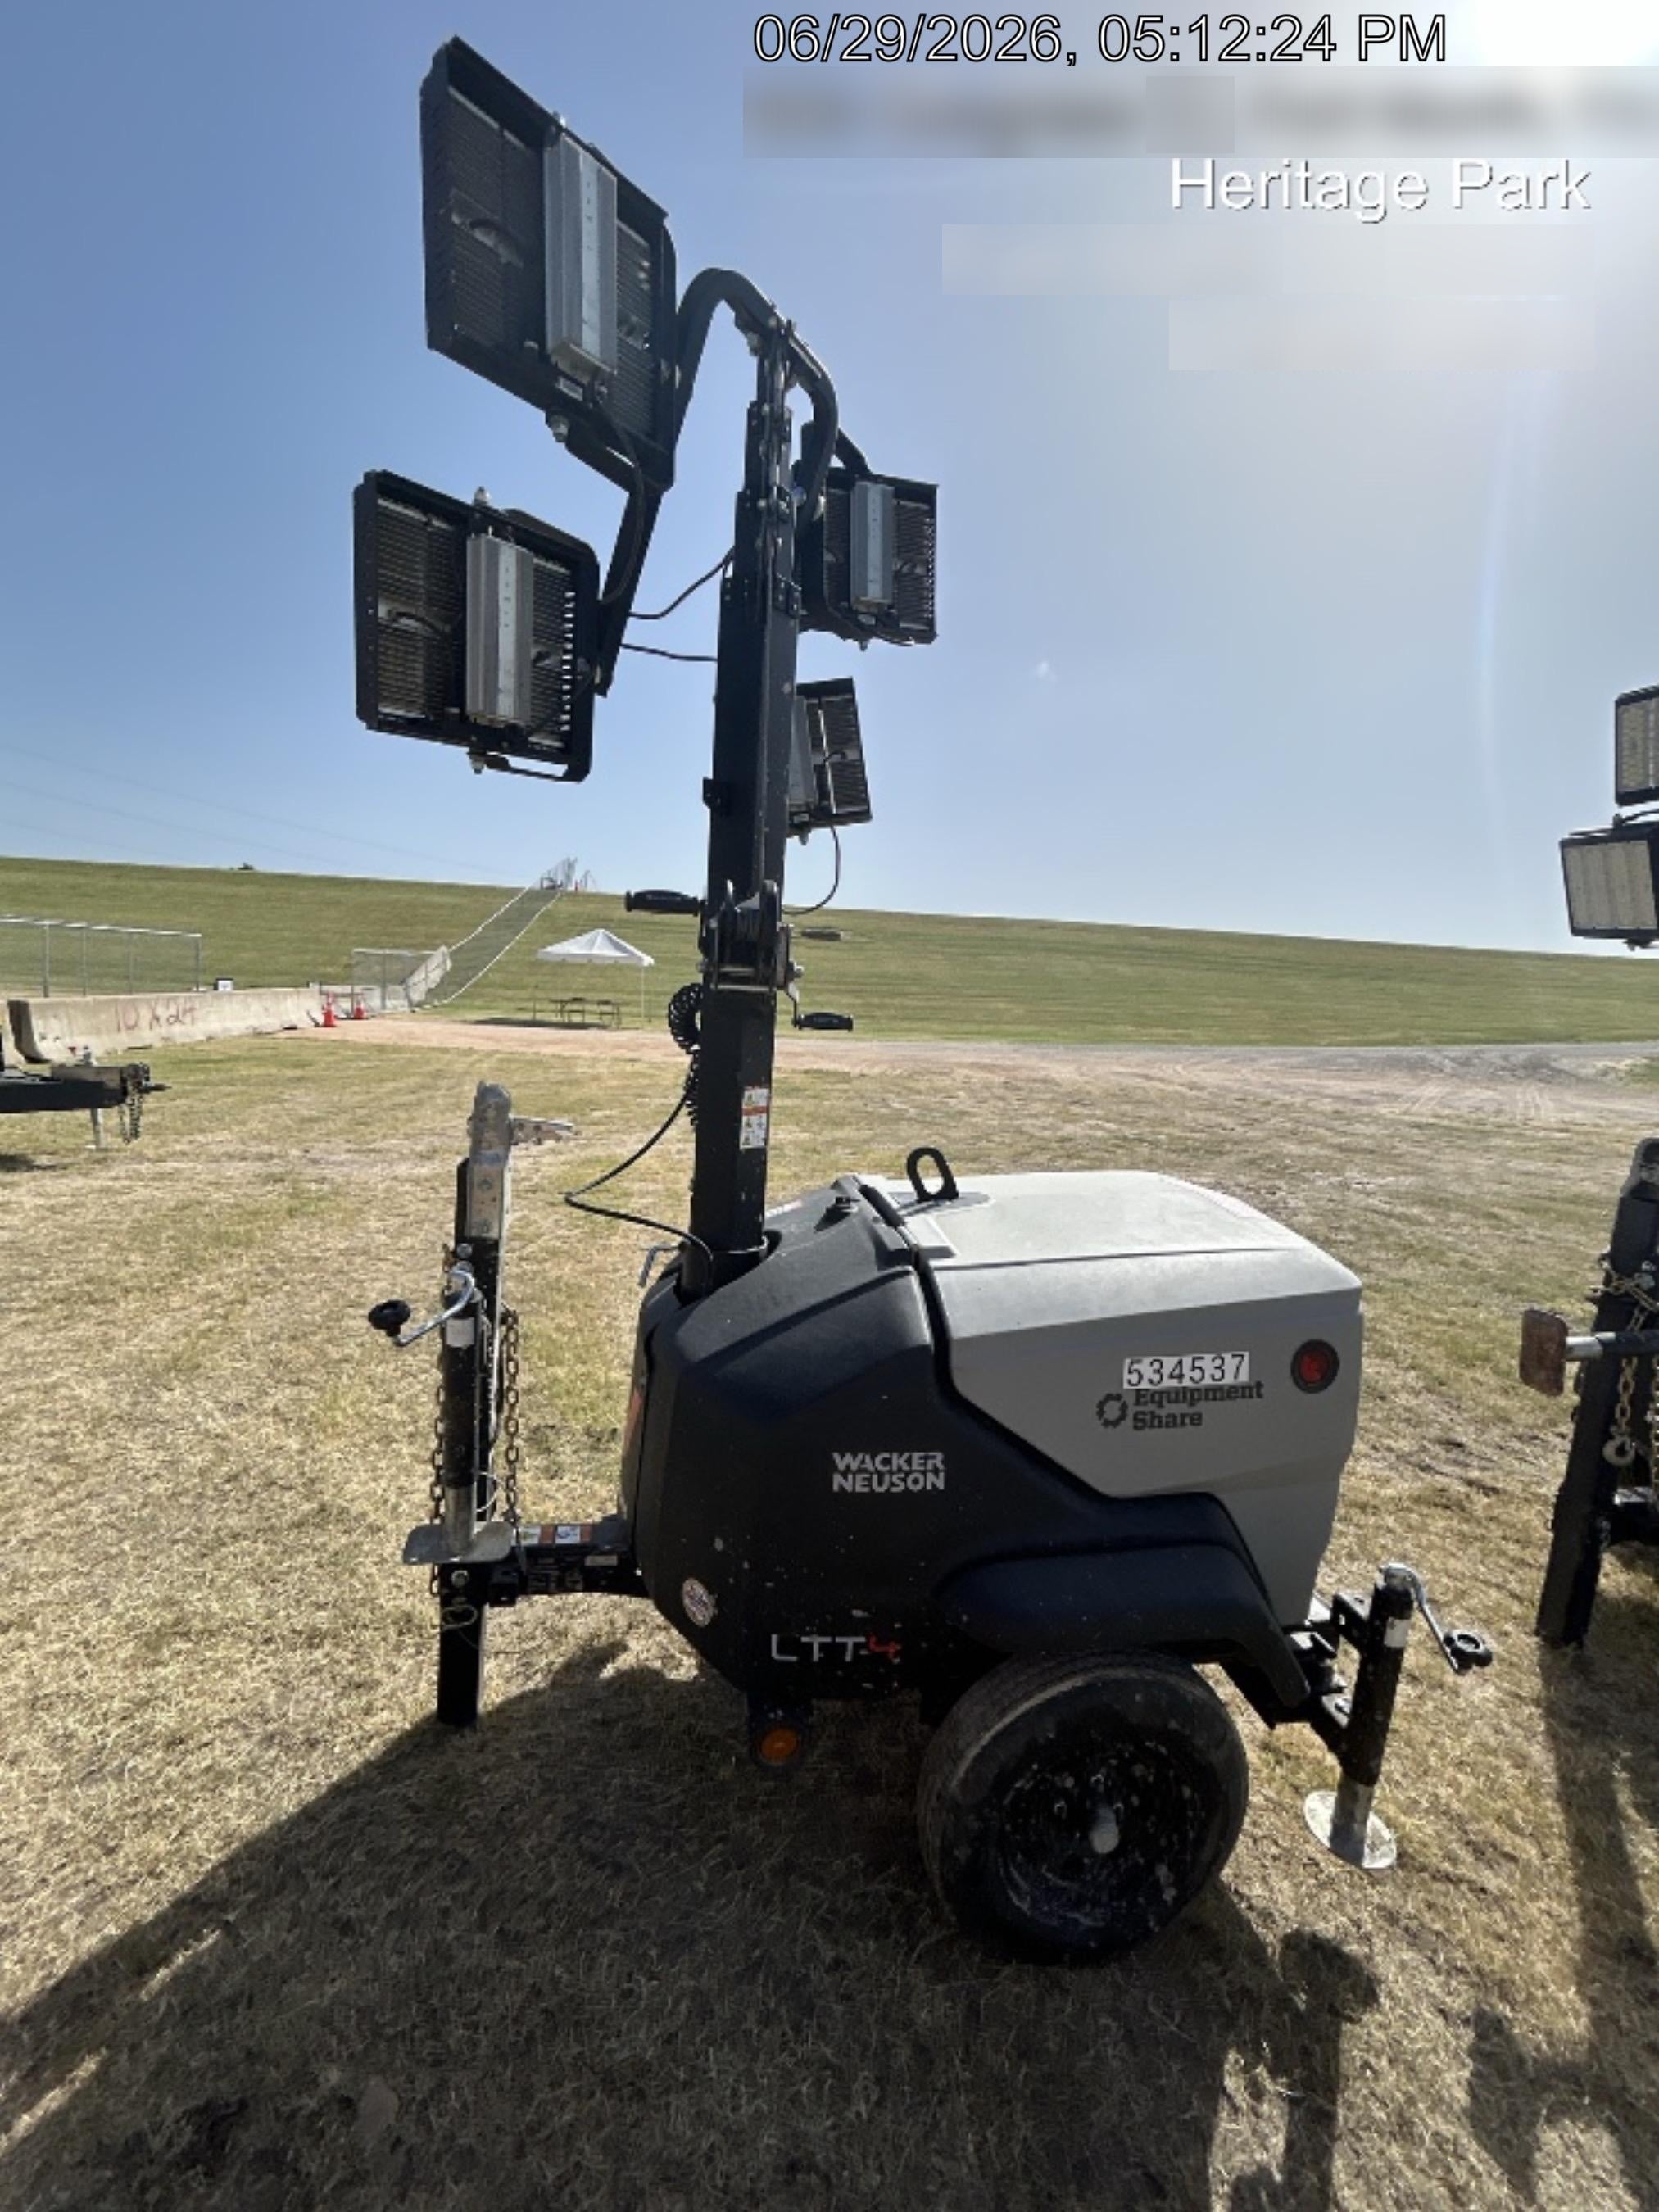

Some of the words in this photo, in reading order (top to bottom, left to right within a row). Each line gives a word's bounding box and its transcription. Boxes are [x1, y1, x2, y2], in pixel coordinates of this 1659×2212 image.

[1126, 1353, 1245, 1387] 534537
[1134, 1380, 1264, 1408] Equipment
[1132, 1410, 1203, 1430] Share
[832, 1451, 945, 1471] WACKER
[832, 1472, 945, 1493] NEUSON
[771, 1633, 899, 1663] LTT4
